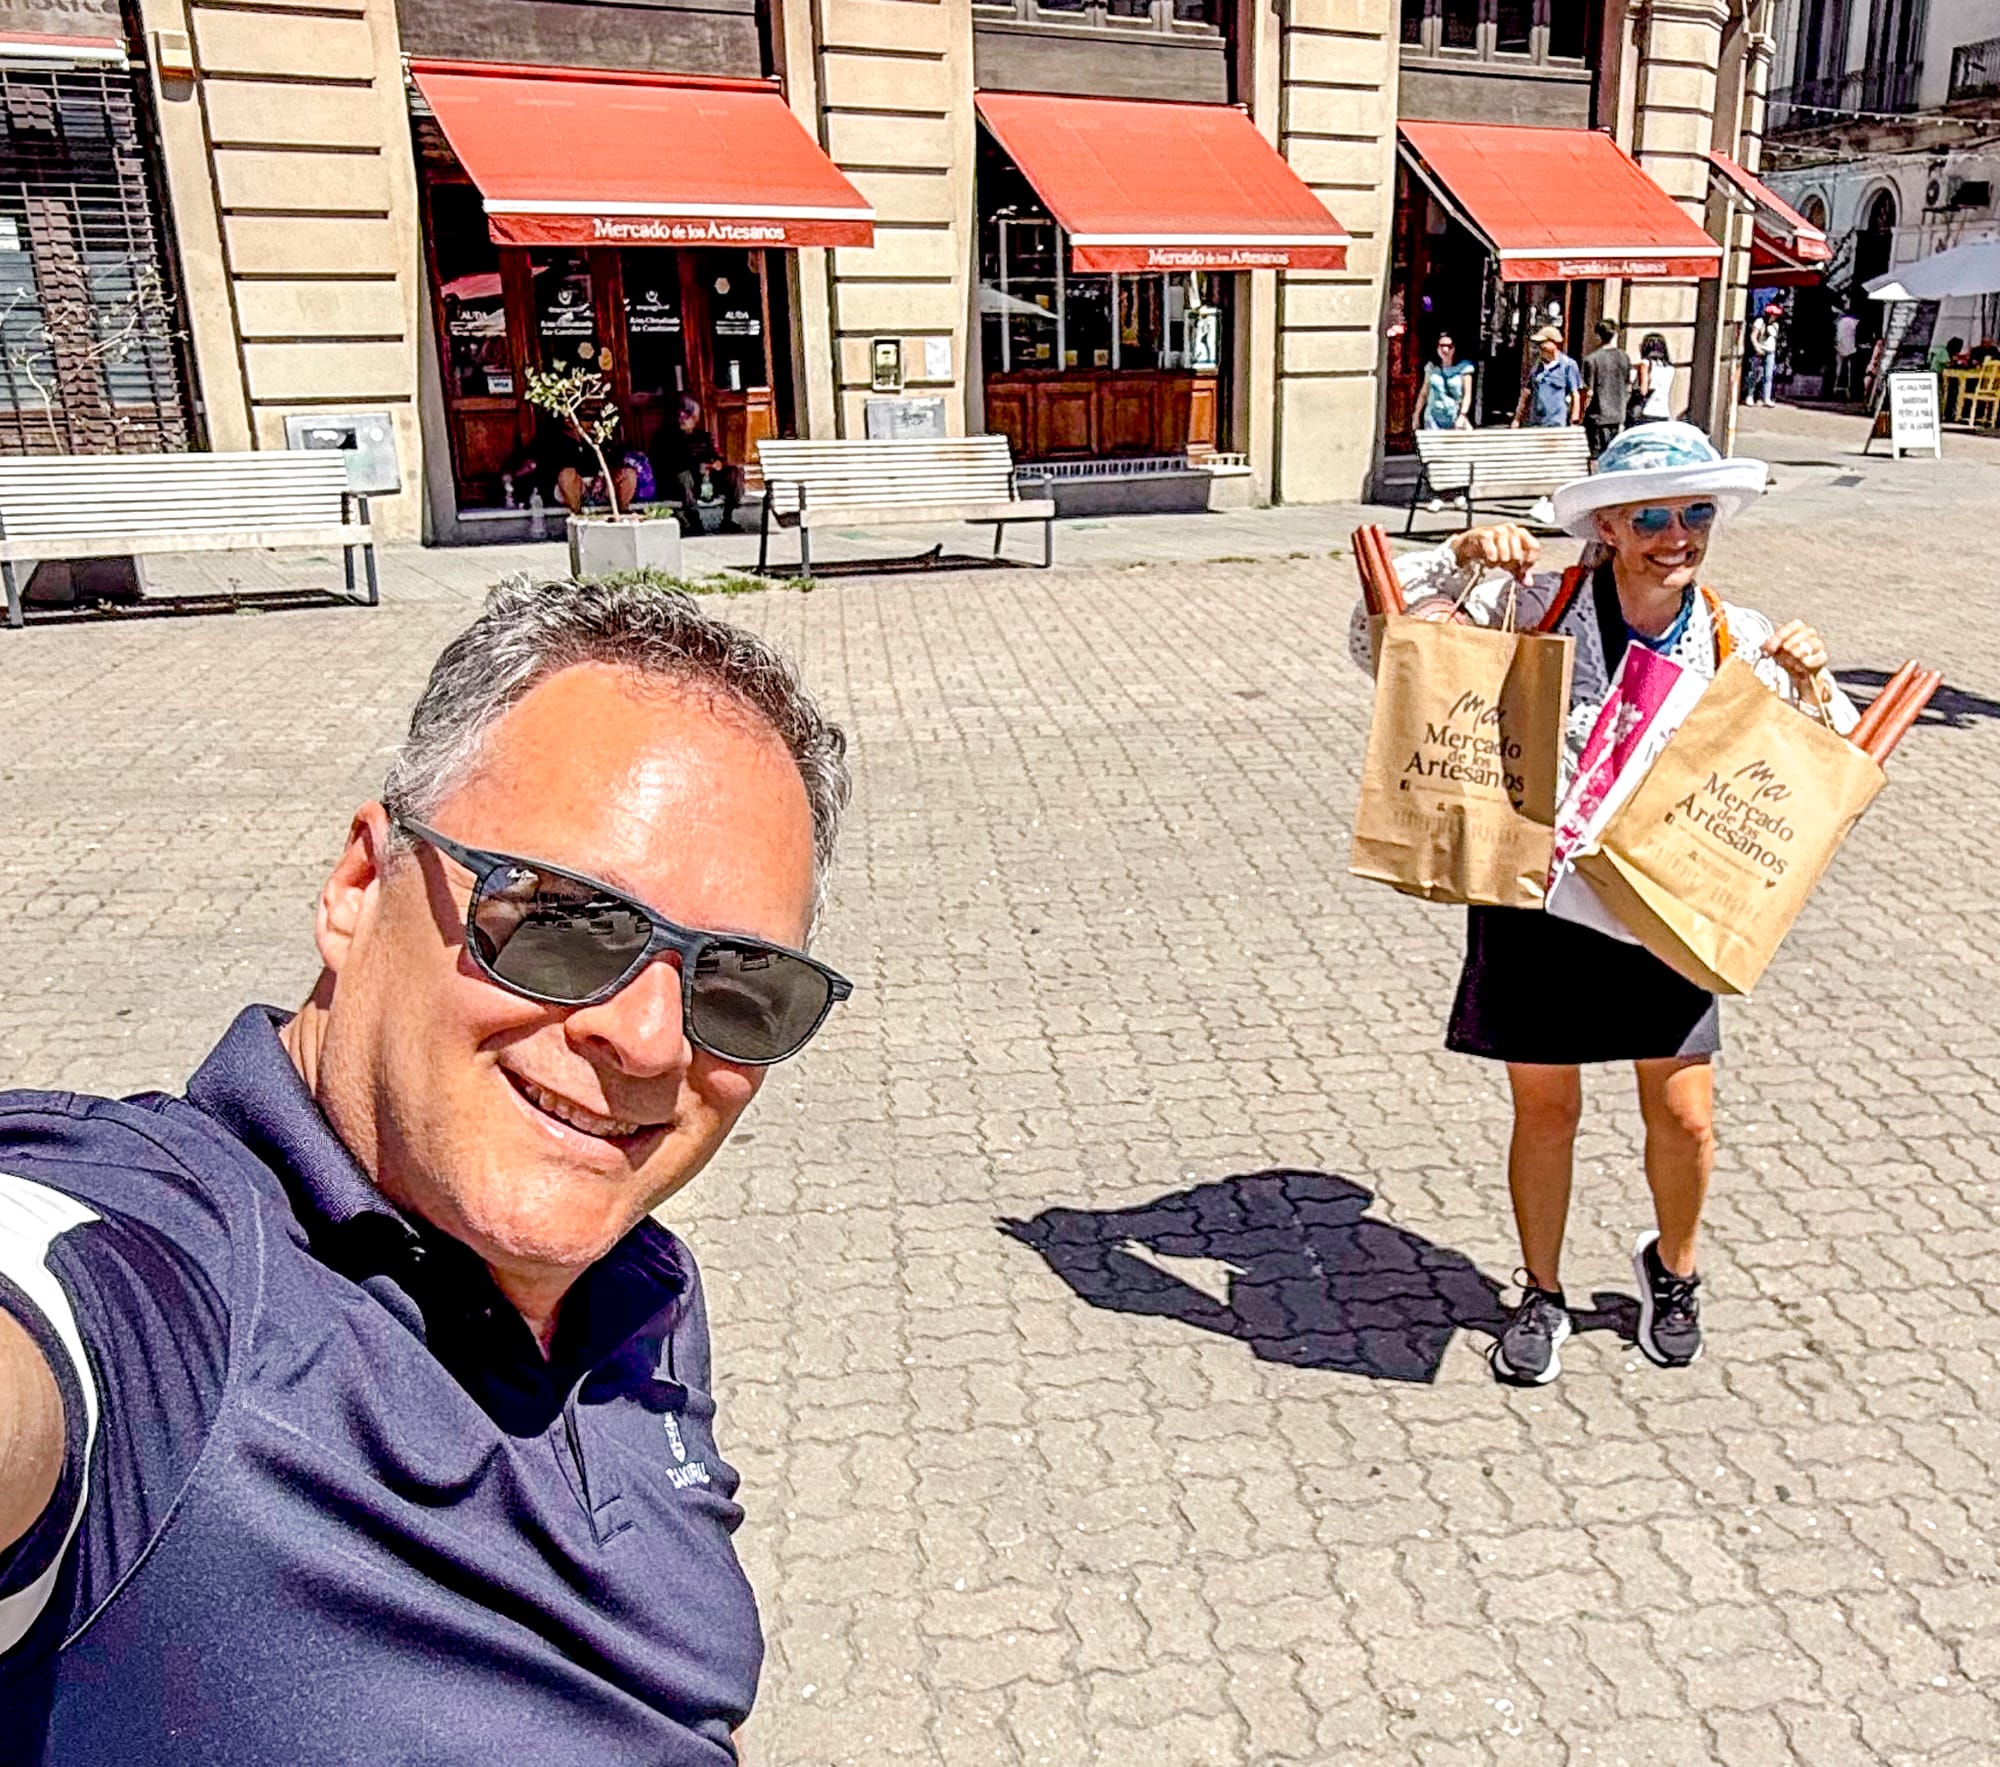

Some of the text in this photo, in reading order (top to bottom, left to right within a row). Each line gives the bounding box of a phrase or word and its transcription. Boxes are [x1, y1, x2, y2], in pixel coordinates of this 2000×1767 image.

[593, 217, 786, 240] Mercado de los Artesanos
[1148, 248, 1204, 265] Mercado
[1231, 249, 1290, 265] Artesanos
[1423, 722, 1522, 759] Mercado
[1404, 751, 1525, 793] Artesanos
[1448, 750, 1491, 768] de los
[1703, 771, 1795, 842] Mercado
[1717, 807, 1761, 840] de los
[1675, 792, 1789, 876] Artesanos
